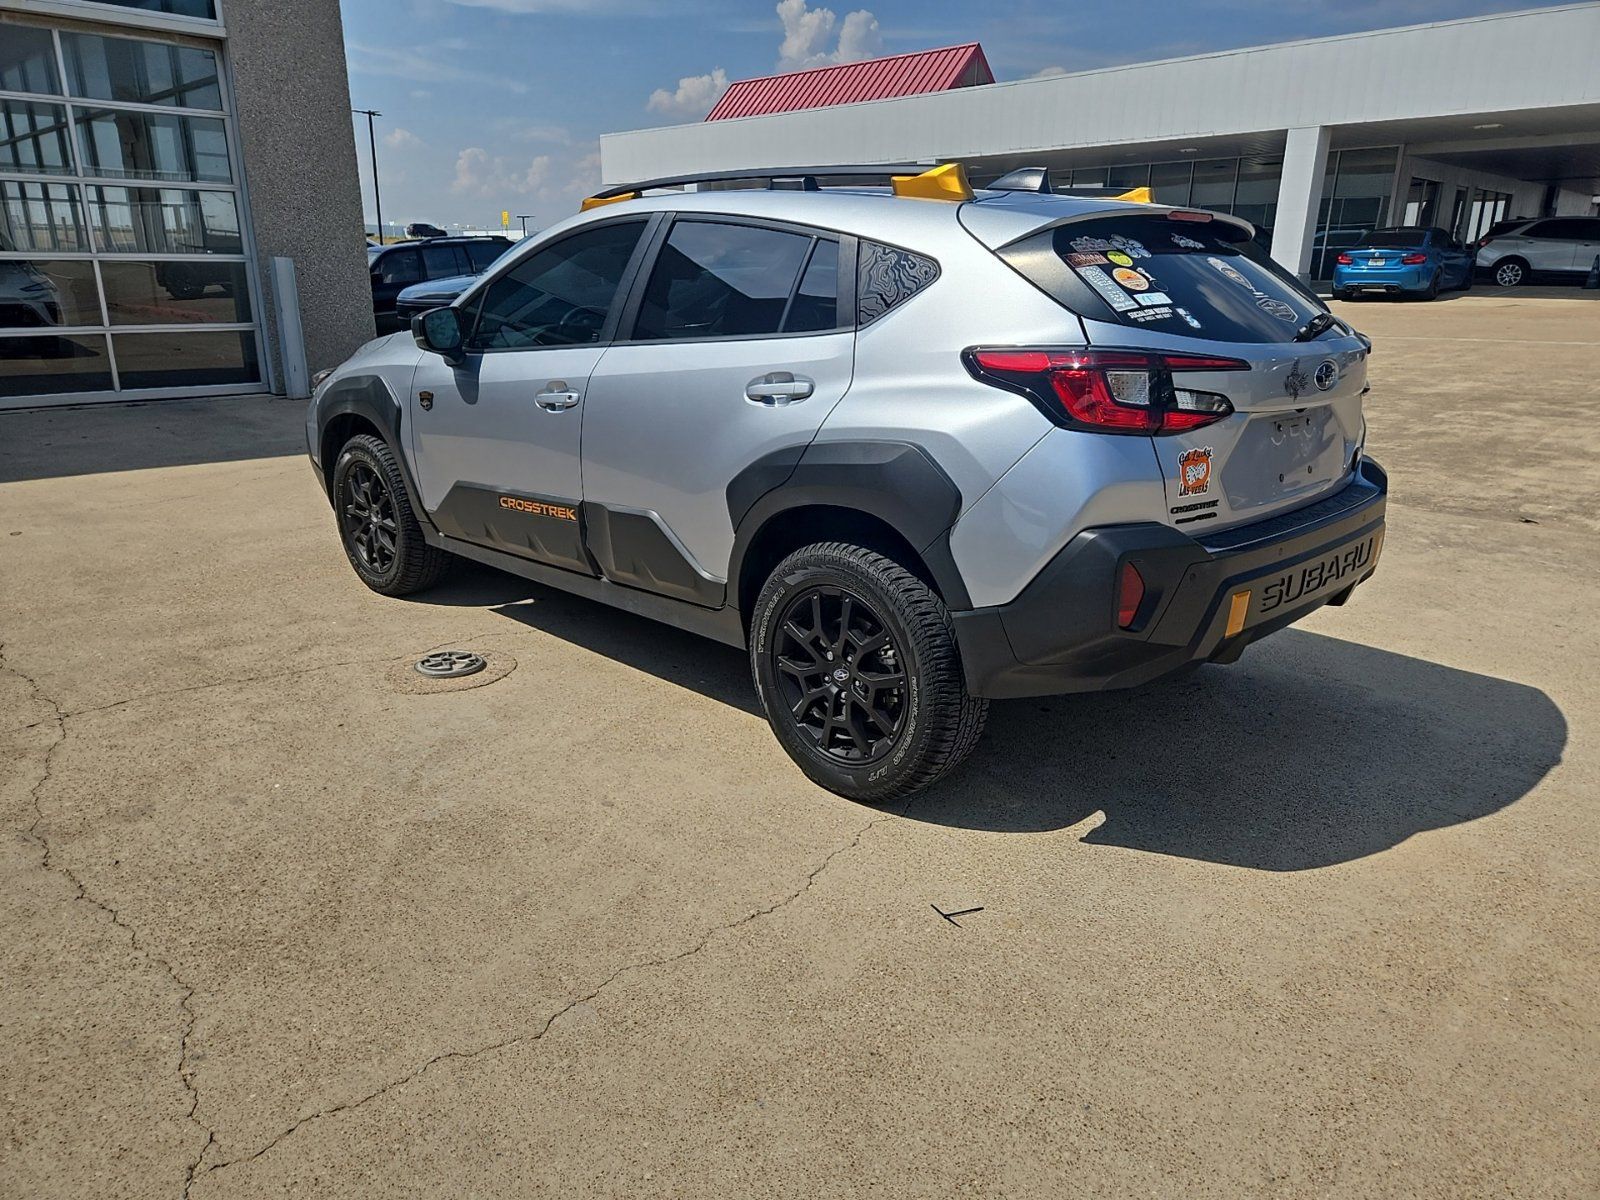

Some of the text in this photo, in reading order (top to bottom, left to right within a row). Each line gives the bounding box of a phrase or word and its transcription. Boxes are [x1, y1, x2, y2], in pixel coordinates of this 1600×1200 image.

[1178, 483, 1190, 497] LAS
[499, 496, 577, 520] CROSSTREK
[1260, 537, 1374, 613] SUBARU
